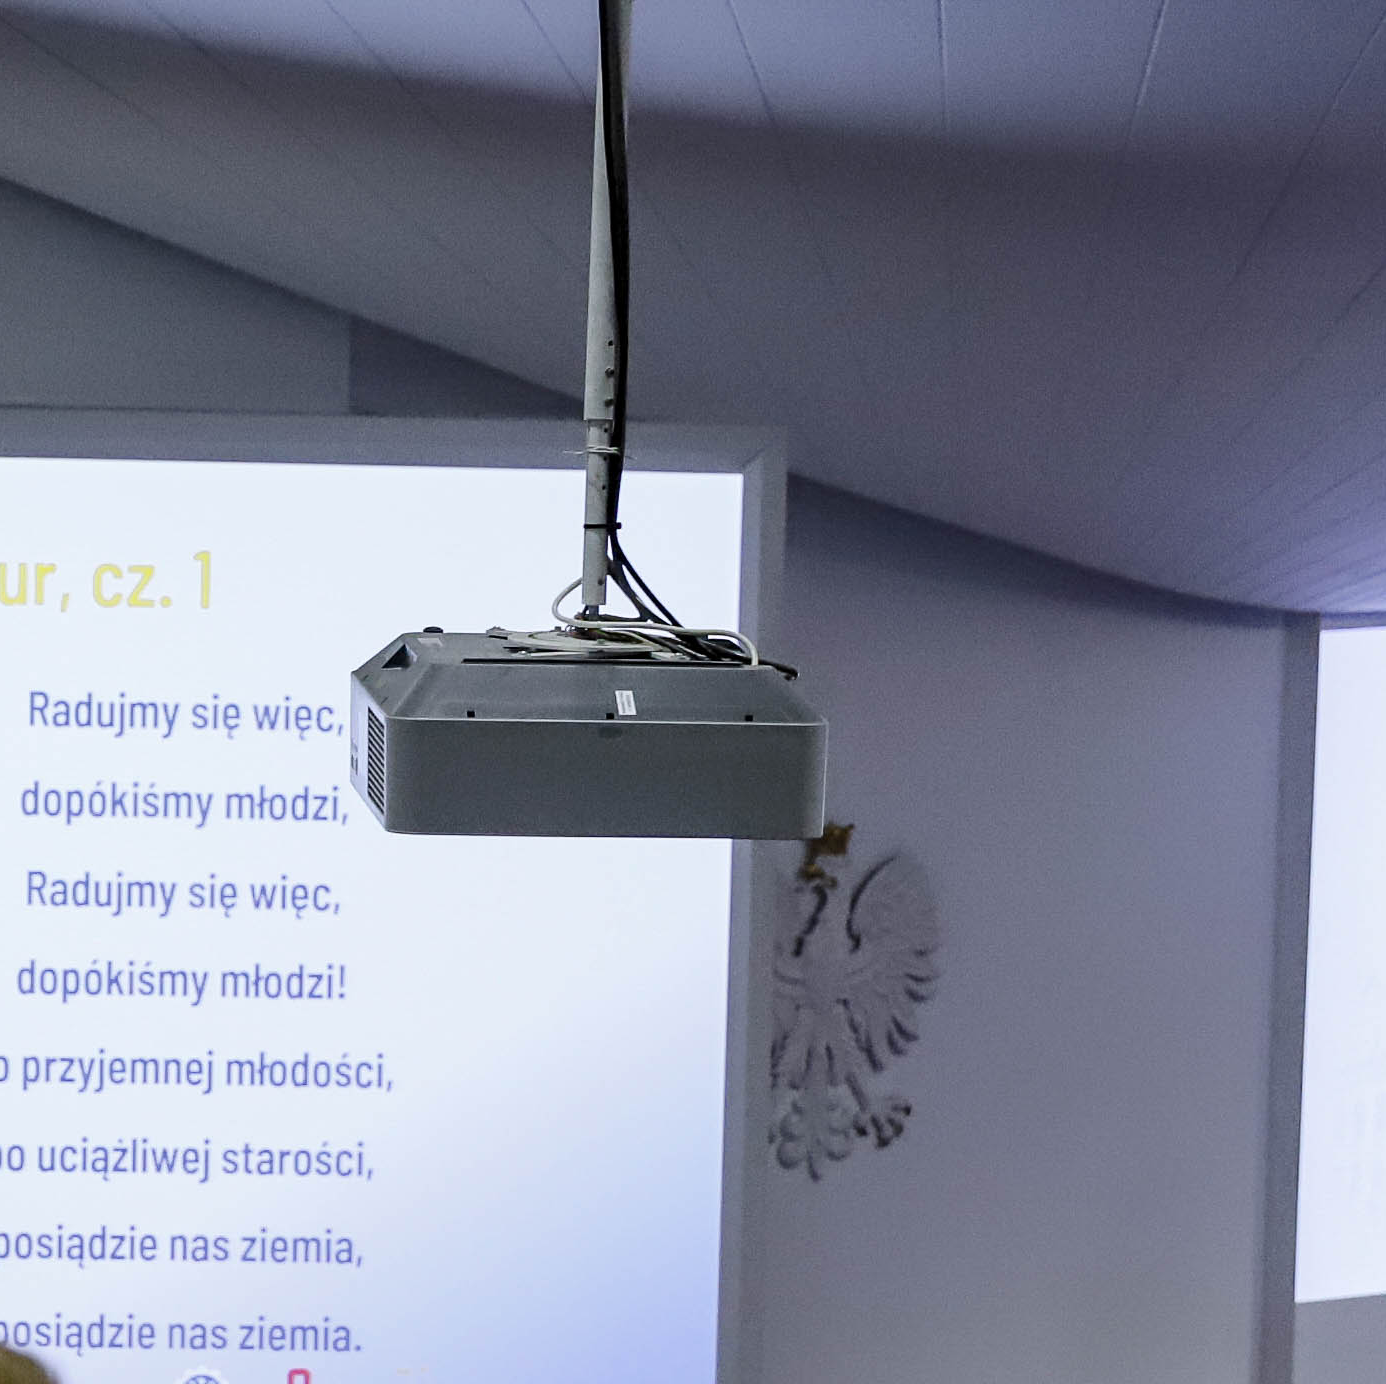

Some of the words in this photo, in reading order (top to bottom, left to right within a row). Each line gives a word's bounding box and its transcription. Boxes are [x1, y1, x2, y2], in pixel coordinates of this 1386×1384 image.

[92, 563, 172, 608] cz.
[193, 551, 212, 609] 1
[29, 690, 180, 739] Radujmy
[191, 693, 241, 739] się
[252, 695, 344, 741] więc,
[21, 780, 214, 829] dopókiśmy
[225, 783, 350, 826] młodzi,
[27, 870, 177, 918] Radujmy
[188, 873, 238, 918] się
[249, 874, 340, 920] więc,
[17, 959, 209, 1007] dopókiśmy
[221, 963, 346, 1000] młodzi!
[22, 1048, 214, 1095] przyjemnej
[226, 1051, 392, 1092] młodości,
[37, 1136, 211, 1184] uciążliwej
[222, 1141, 373, 1180] starości,
[170, 1234, 230, 1263] nas
[240, 1227, 362, 1268] ziemia,
[168, 1323, 228, 1351] nas
[238, 1315, 362, 1353] ziemia.
